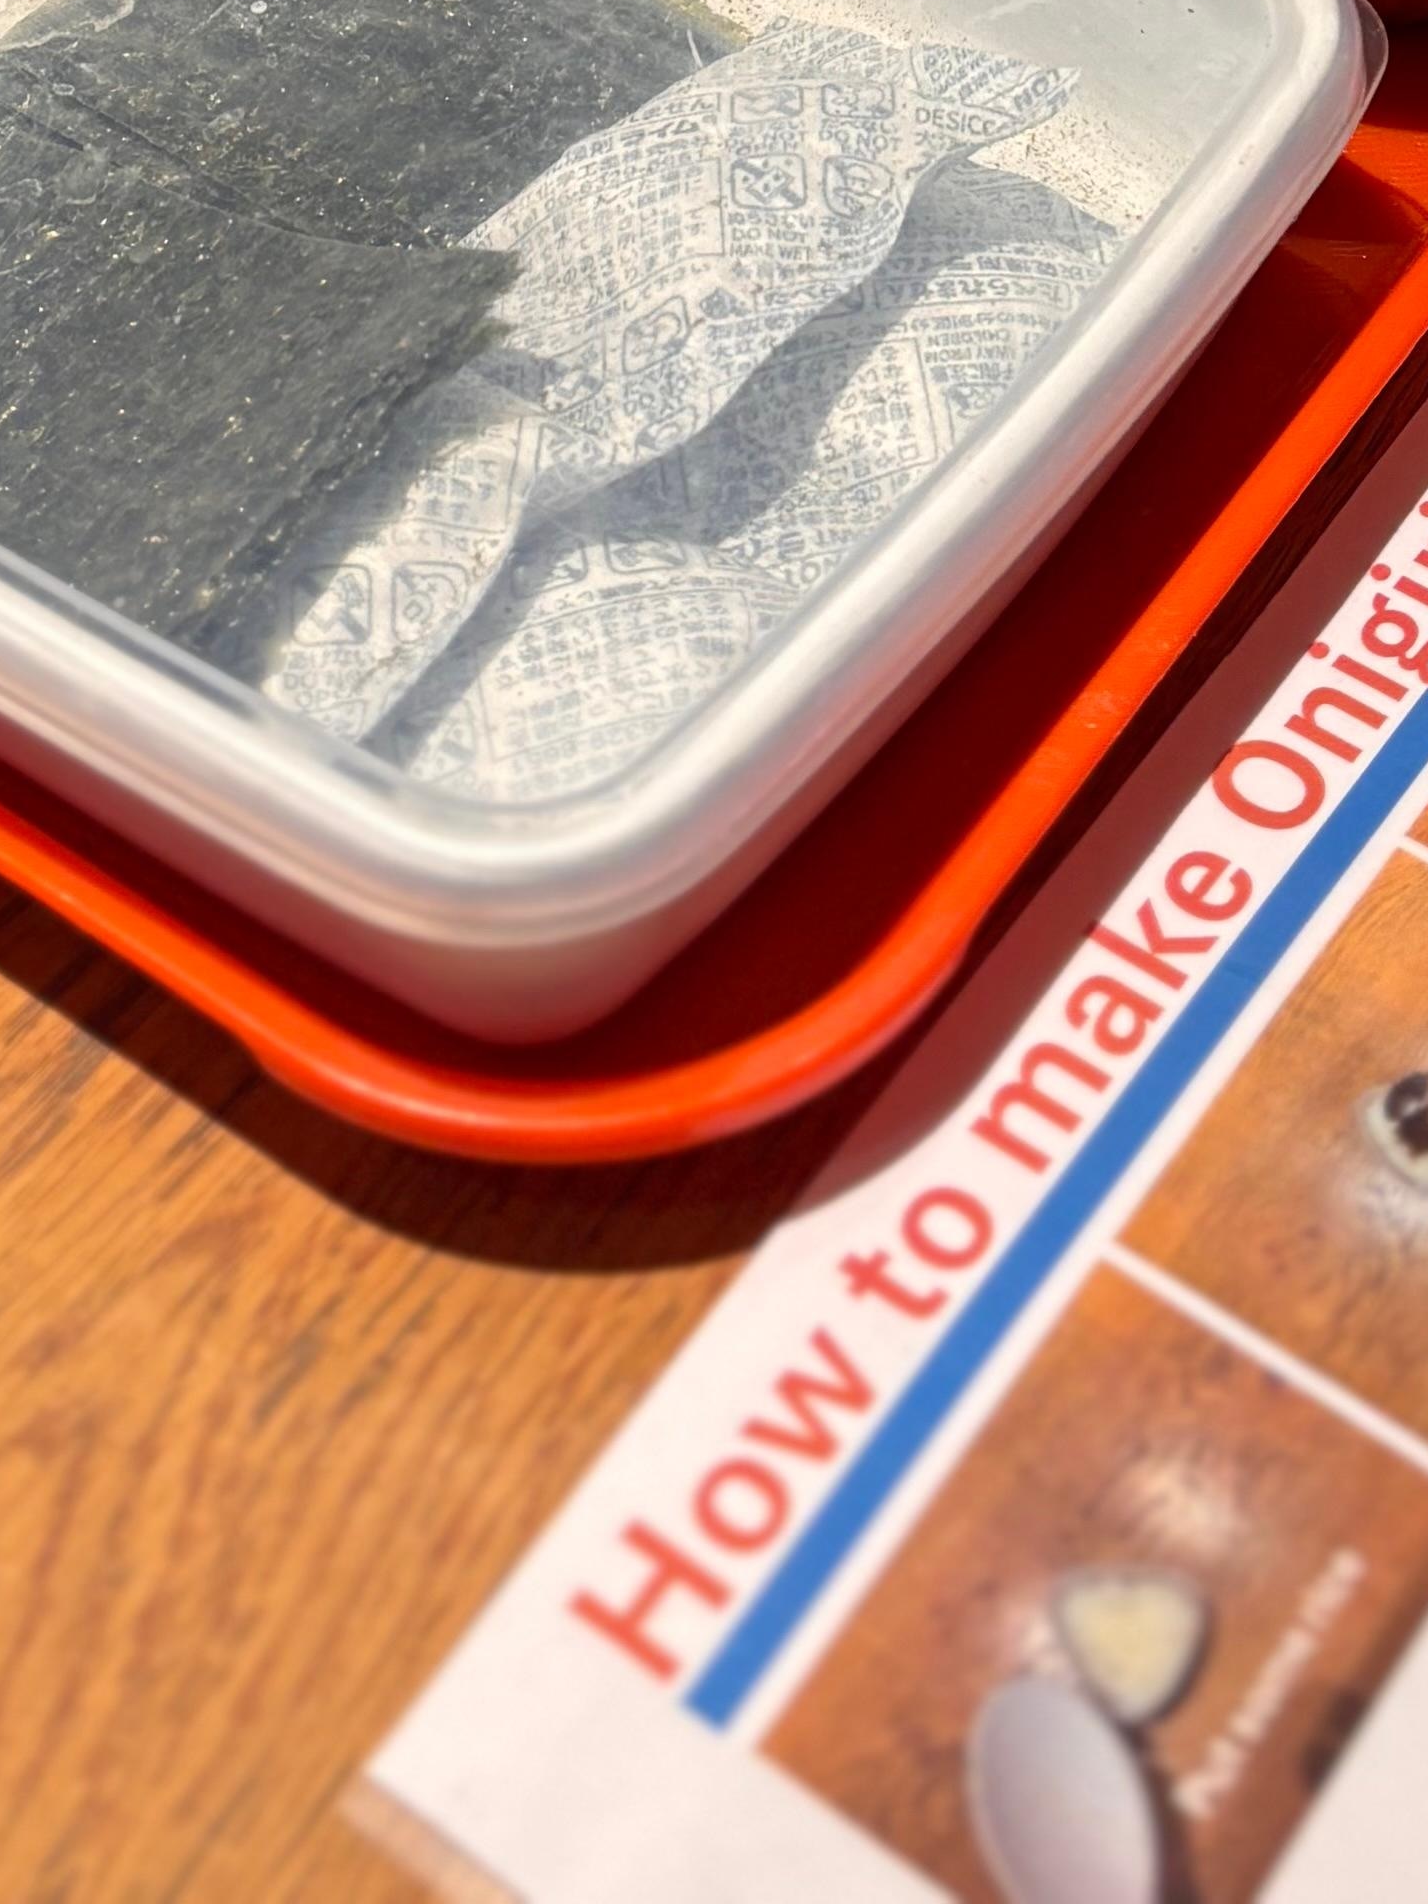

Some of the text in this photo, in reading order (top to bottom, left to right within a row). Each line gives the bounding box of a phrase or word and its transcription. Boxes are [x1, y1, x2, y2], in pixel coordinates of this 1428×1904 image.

[569, 1328, 876, 1686] How
[838, 1184, 996, 1324] to
[968, 847, 1254, 1176] make
